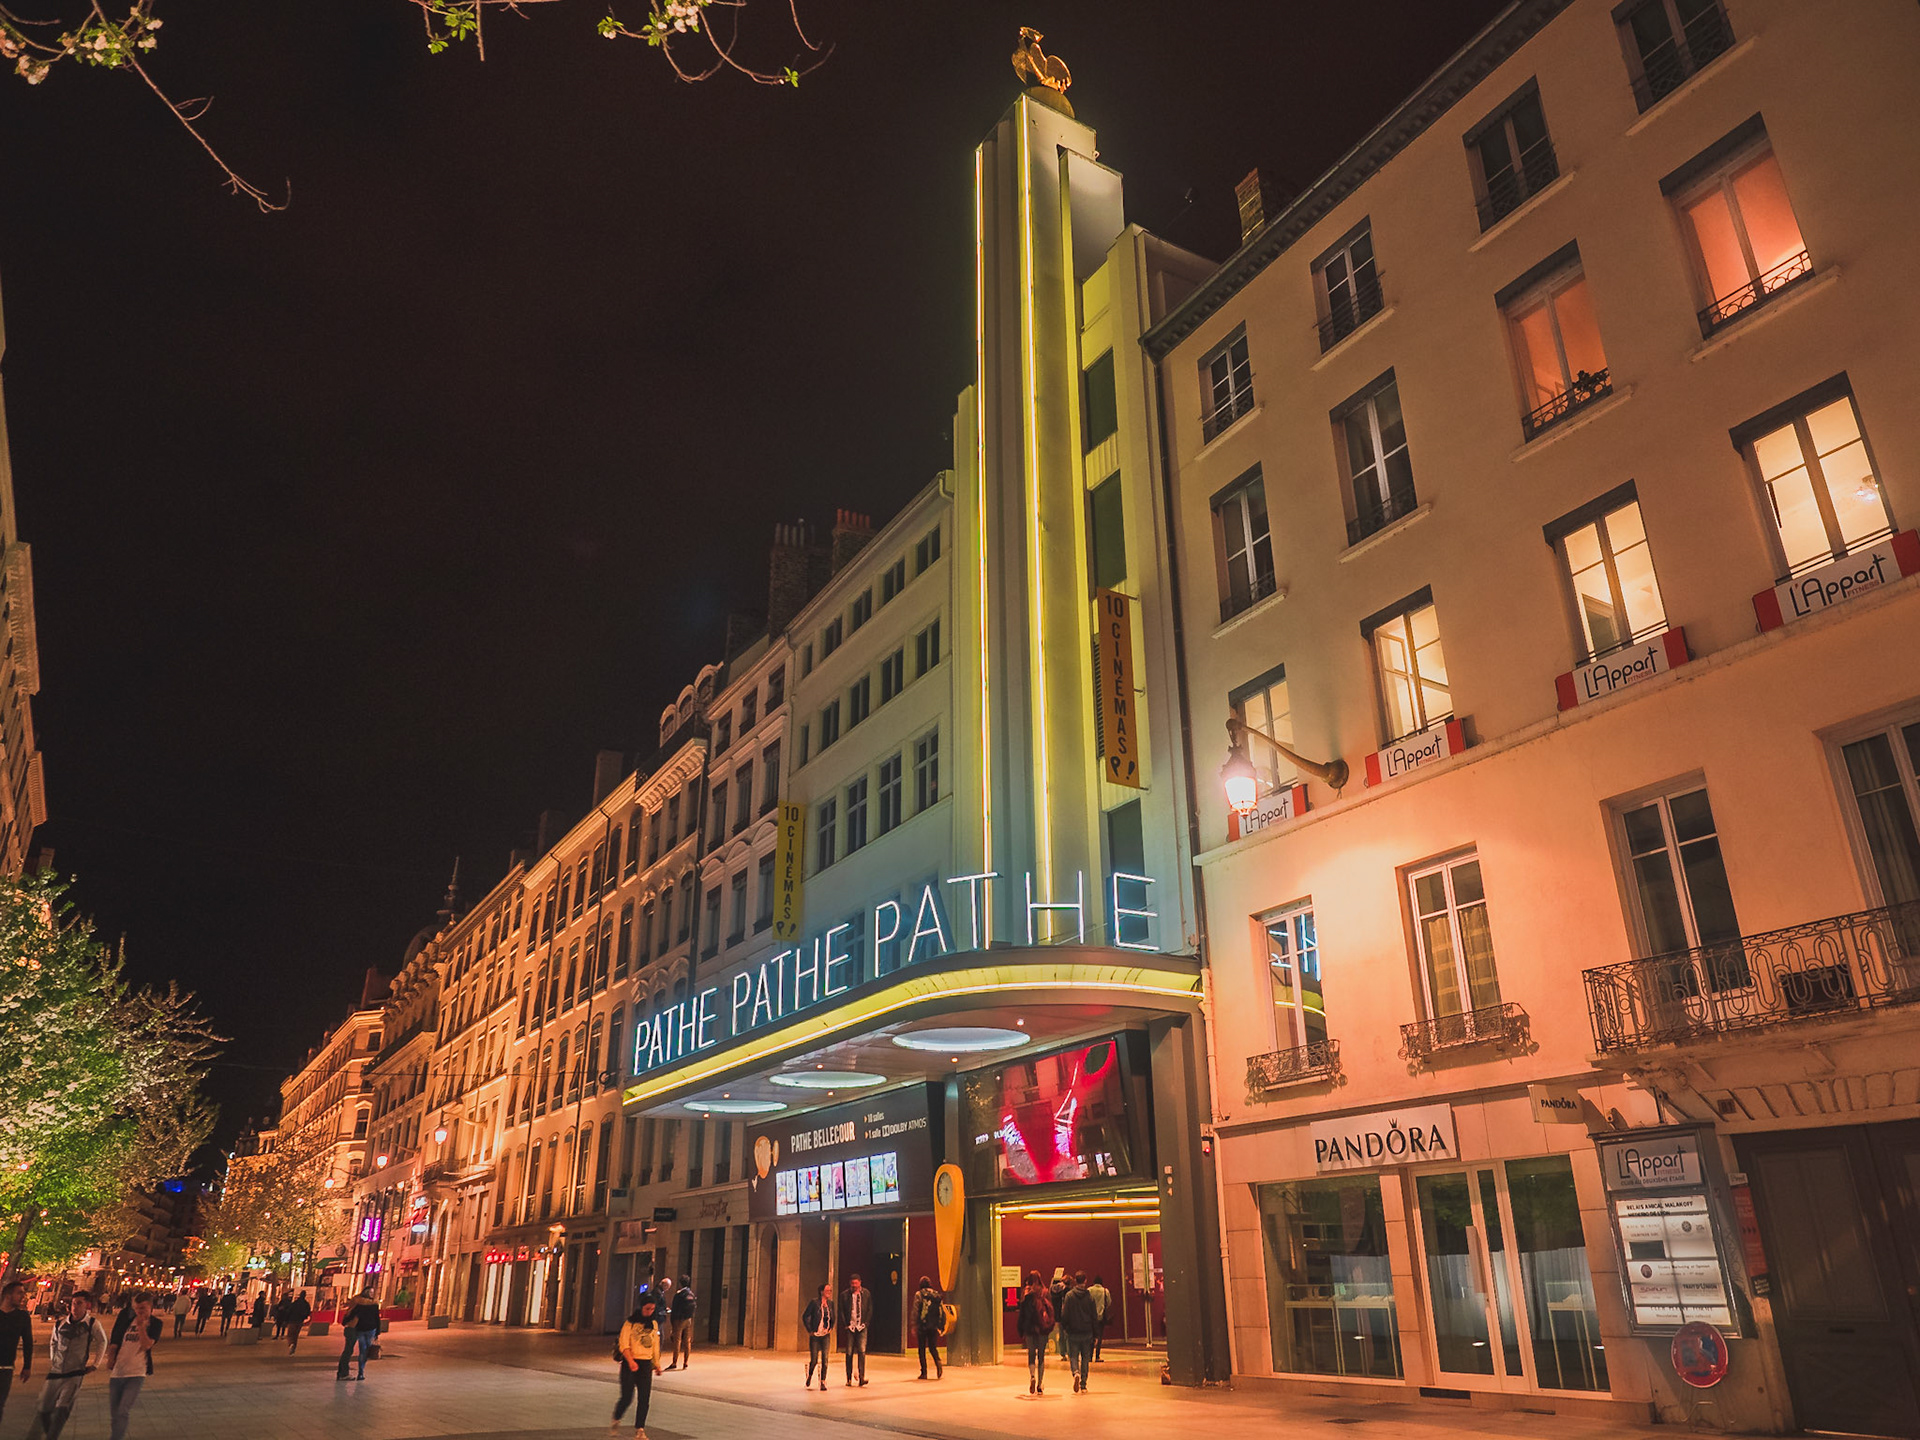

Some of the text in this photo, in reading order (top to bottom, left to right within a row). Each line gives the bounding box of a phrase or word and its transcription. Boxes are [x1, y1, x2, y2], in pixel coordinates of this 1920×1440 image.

[1789, 553, 1887, 617] L'Appart
[1847, 579, 1880, 596] FITNESS
[1105, 594, 1124, 619] 10
[1584, 645, 1658, 699] L'Appart
[1627, 668, 1653, 682] FITNESS
[784, 806, 799, 822] 10
[633, 869, 1161, 1076] PATHE PATHE PATHE
[1541, 1097, 1578, 1110] PANDORA
[790, 1120, 856, 1154] PATHE BELLECOUR
[890, 1121, 908, 1135] DOLBY
[908, 1117, 927, 1130] ATMOS
[1315, 1120, 1447, 1164] PANDORA
[1616, 1144, 1687, 1179] L'Appart
